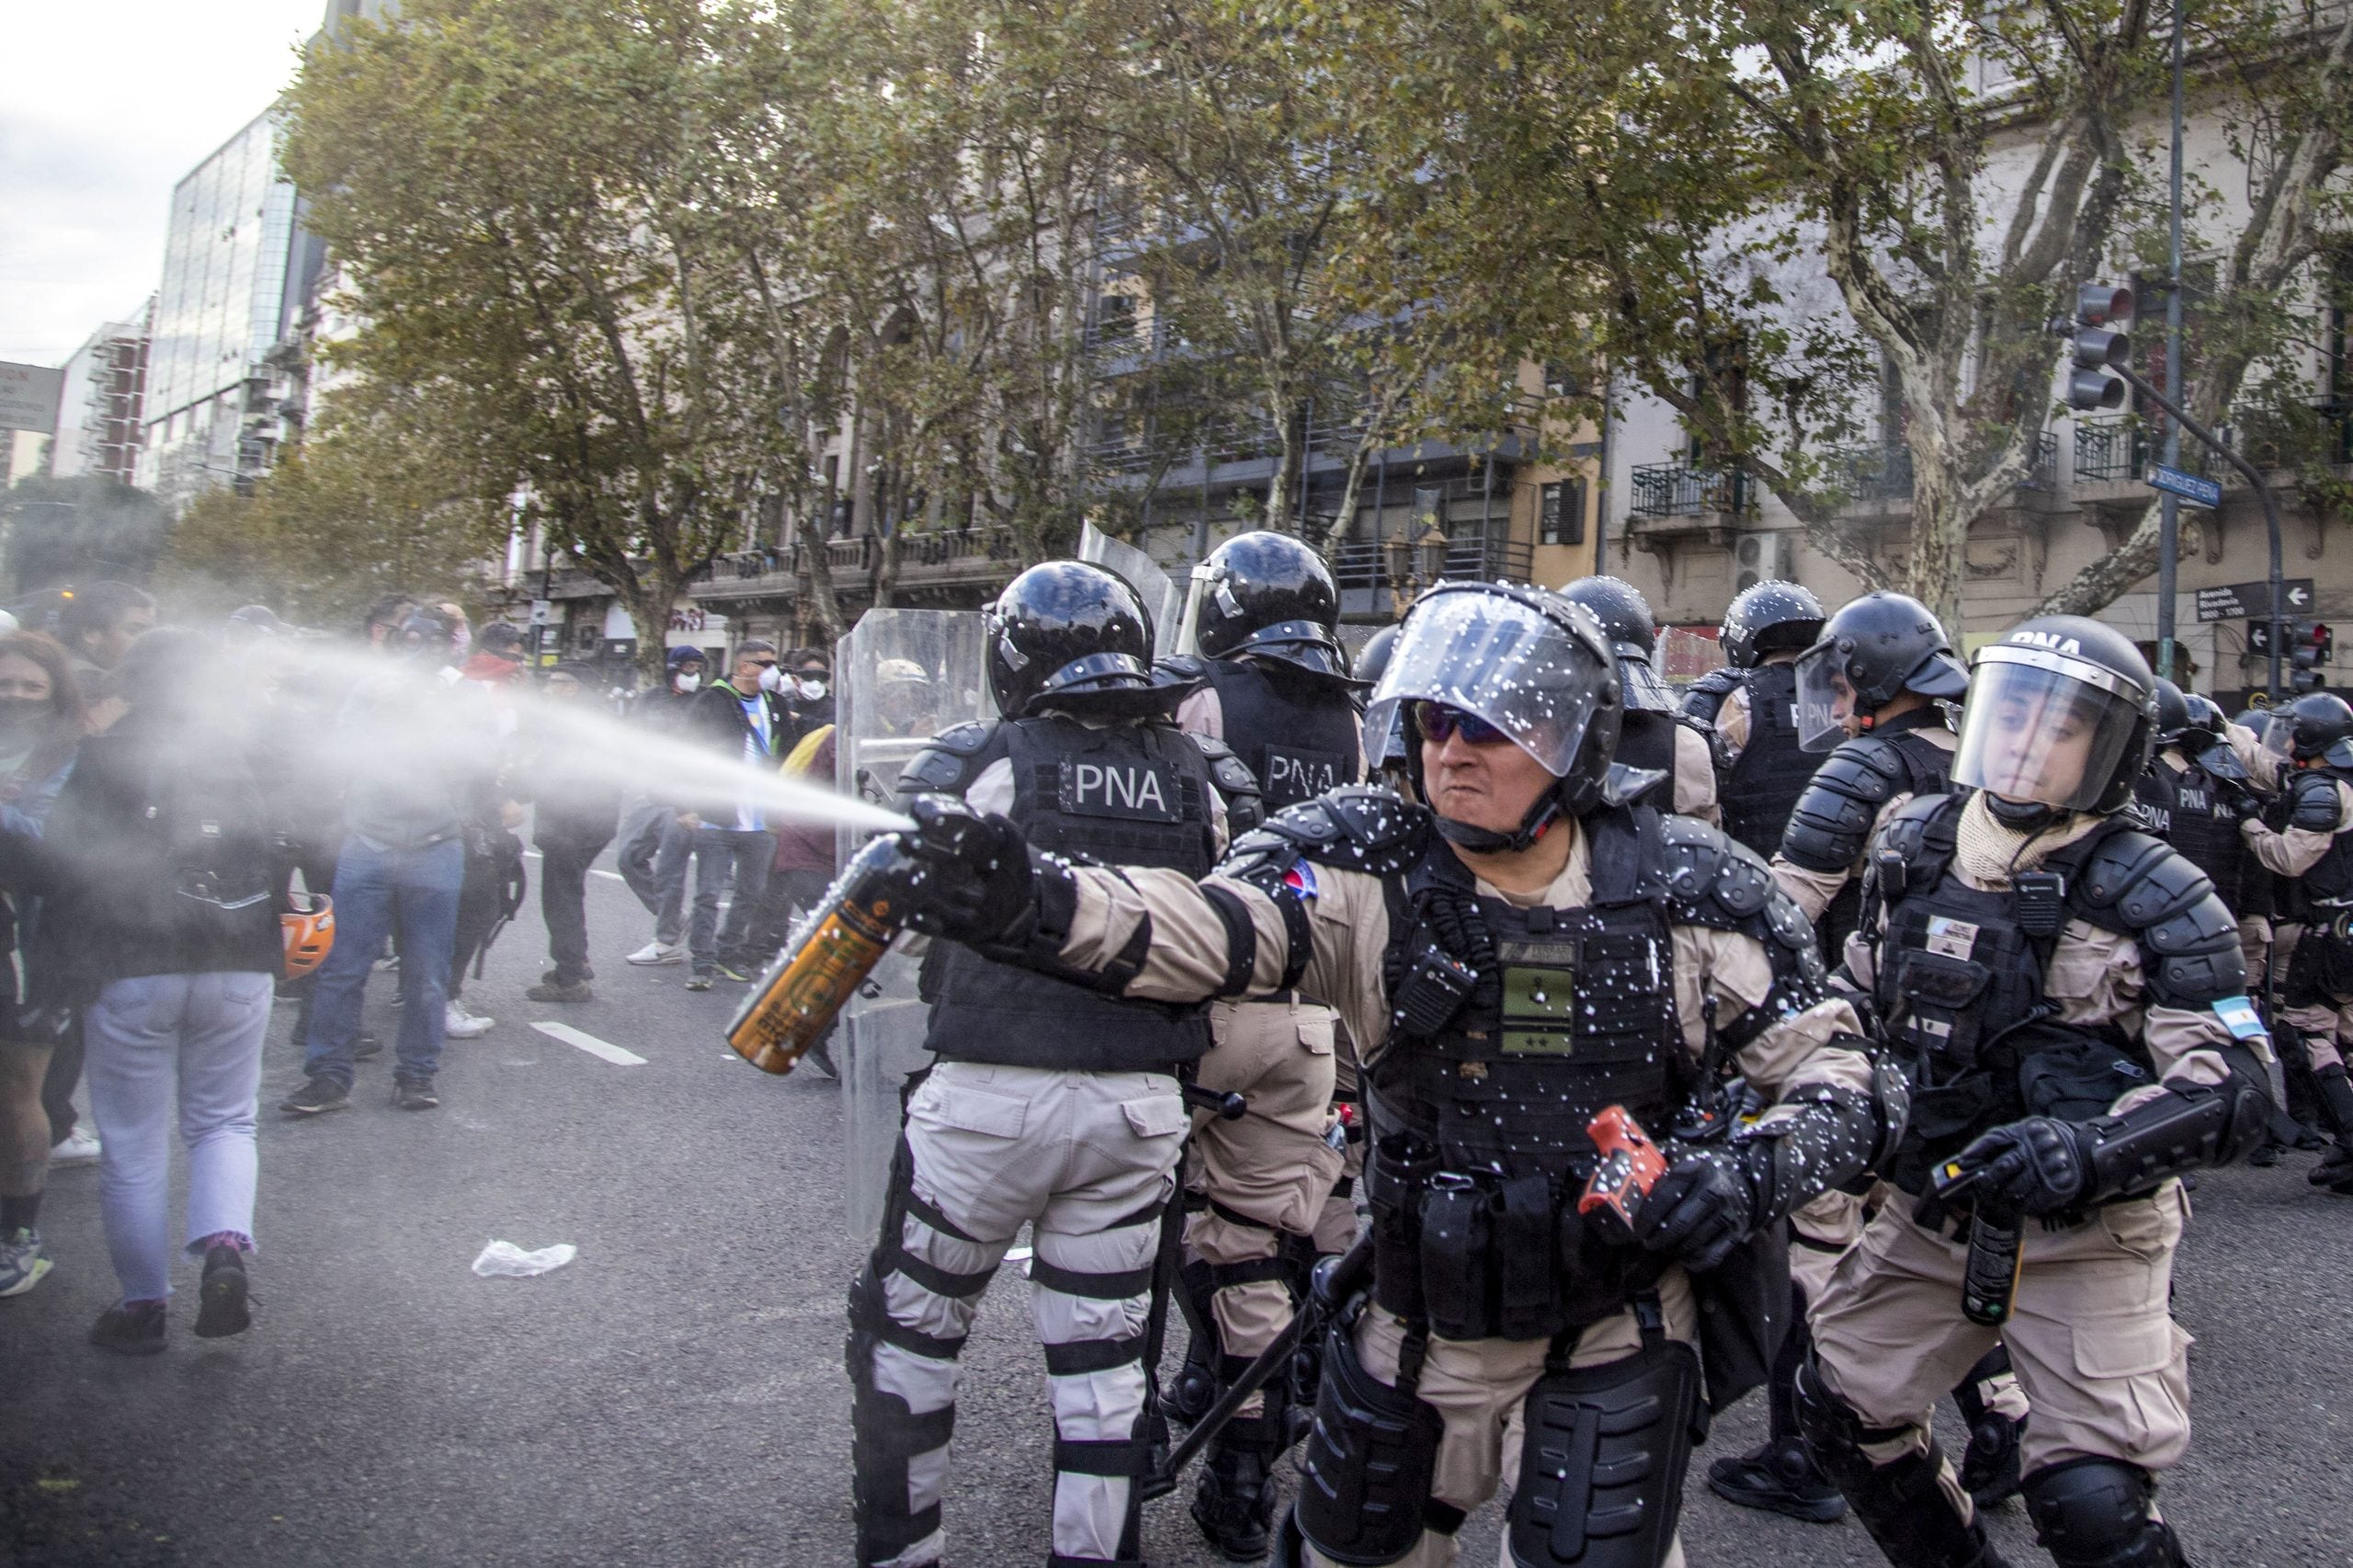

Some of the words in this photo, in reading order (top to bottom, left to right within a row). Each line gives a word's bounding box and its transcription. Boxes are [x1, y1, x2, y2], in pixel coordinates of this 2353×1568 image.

[1075, 764, 1166, 812] PNA
[1267, 756, 1334, 798] PNA
[2141, 803, 2170, 831] PNA
[2179, 789, 2207, 810] PNA
